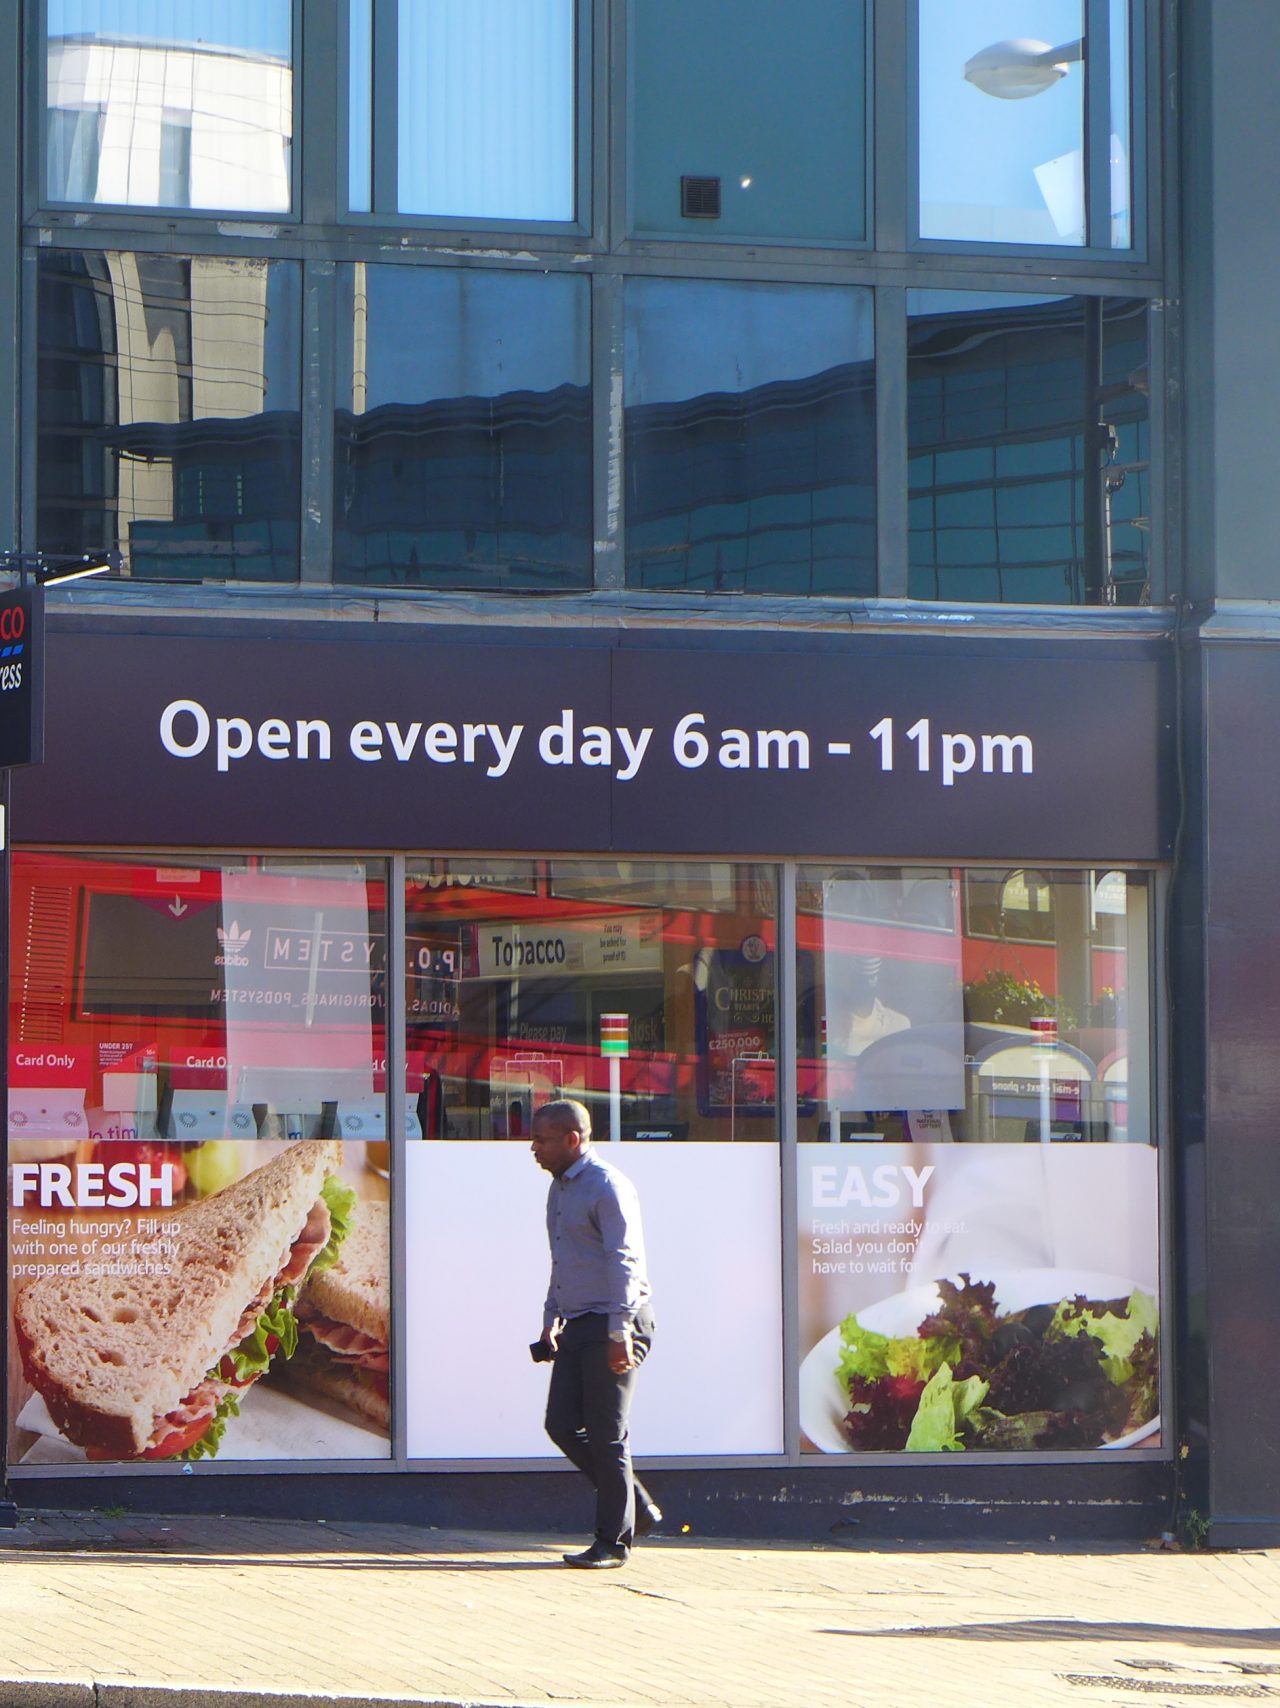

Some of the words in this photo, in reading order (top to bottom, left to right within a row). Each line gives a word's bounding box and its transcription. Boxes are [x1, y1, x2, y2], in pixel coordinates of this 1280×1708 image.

[160, 699, 331, 772] Open
[350, 721, 523, 777] every
[538, 709, 653, 779] day
[673, 713, 809, 768] 6am
[828, 743, 851, 754] -
[869, 718, 1033, 785] 11pm
[492, 936, 565, 966] Tobacco
[715, 987, 777, 1011] CHRISTM
[520, 1023, 548, 1041] Please
[550, 1025, 567, 1044] pay
[99, 1042, 120, 1050] UNDER
[16, 1053, 44, 1066] Card
[46, 1053, 75, 1069] Only
[186, 1056, 214, 1068] Card
[12, 1163, 174, 1207] FRESH
[812, 1165, 935, 1207] EASY
[12, 1219, 66, 1238] Feeling
[70, 1219, 131, 1238] hungry?
[137, 1219, 157, 1234] Fill
[161, 1222, 181, 1238] up
[812, 1219, 850, 1234] Fresh
[853, 1219, 879, 1234] and
[883, 1219, 922, 1237] ready
[12, 1240, 45, 1255] with
[49, 1243, 78, 1255] one
[81, 1240, 99, 1255] of
[101, 1243, 127, 1255] our
[130, 1239, 180, 1259] freshly
[812, 1239, 852, 1254] Salad
[856, 1242, 883, 1257] you
[887, 1239, 921, 1254] don'
[12, 1260, 80, 1279] prepared
[84, 1260, 171, 1275] sandwiches
[812, 1258, 846, 1273] have
[850, 1260, 864, 1273] to
[867, 1258, 896, 1273] wait
